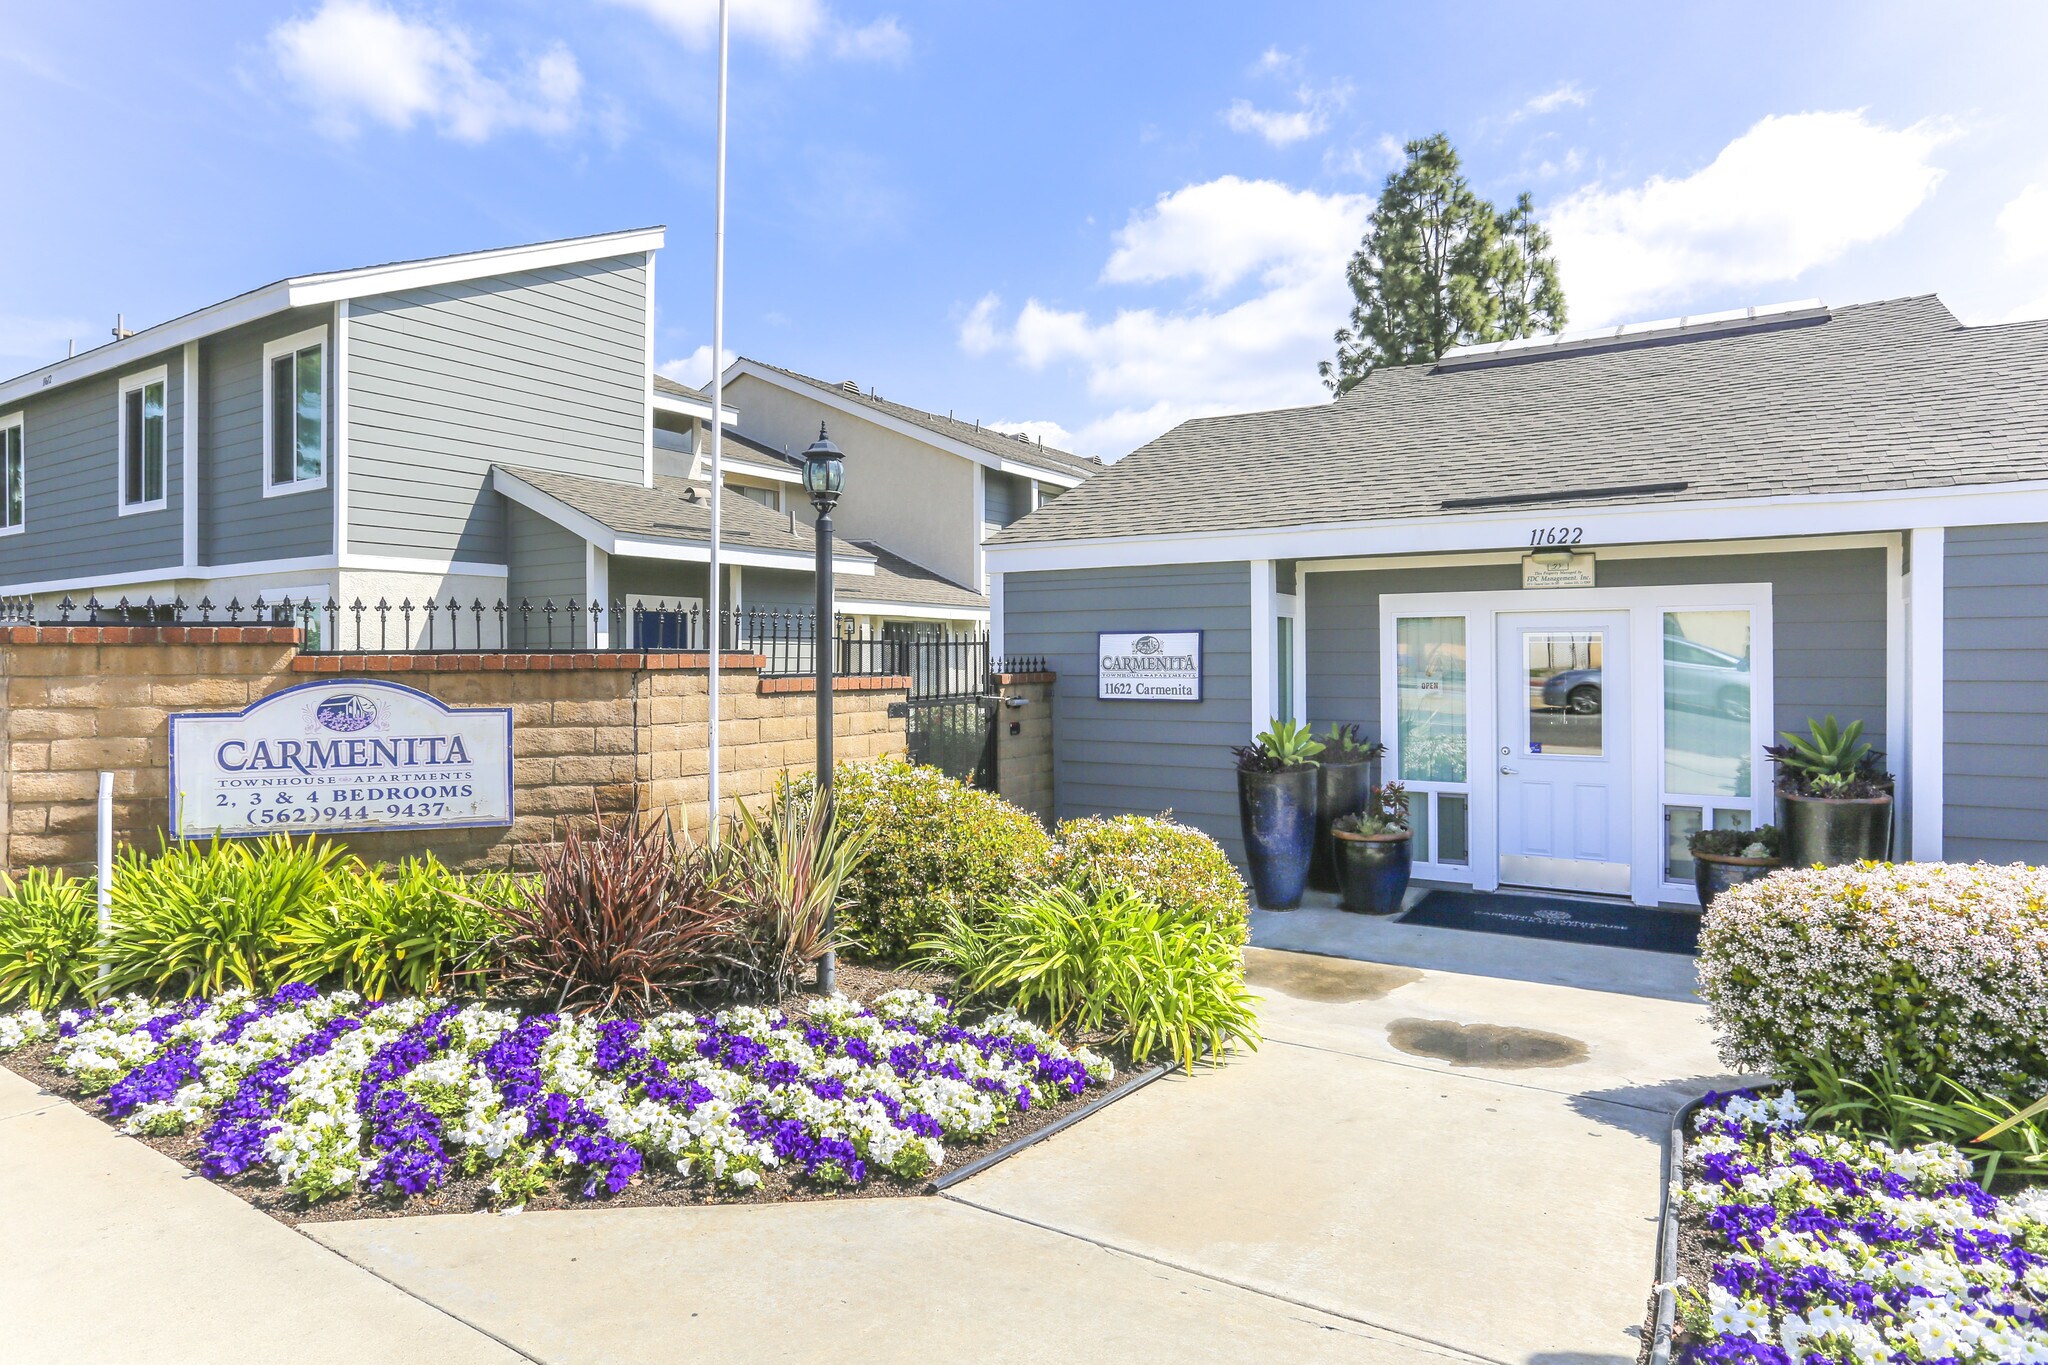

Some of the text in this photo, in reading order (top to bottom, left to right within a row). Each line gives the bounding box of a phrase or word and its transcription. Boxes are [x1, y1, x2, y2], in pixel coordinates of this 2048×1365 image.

[1529, 526, 1583, 546] 11622
[1102, 656, 1196, 674] CARMENITA
[1105, 682, 1193, 696] 11622 Carmenita
[1421, 682, 1439, 690] OPEN
[216, 735, 473, 776] CARMENITA
[217, 771, 473, 787] TOWNHOUSE APARTMENTS
[215, 784, 473, 808] 2, 3 & 4 BEDROOMS
[246, 801, 446, 825] (562)944-9437
